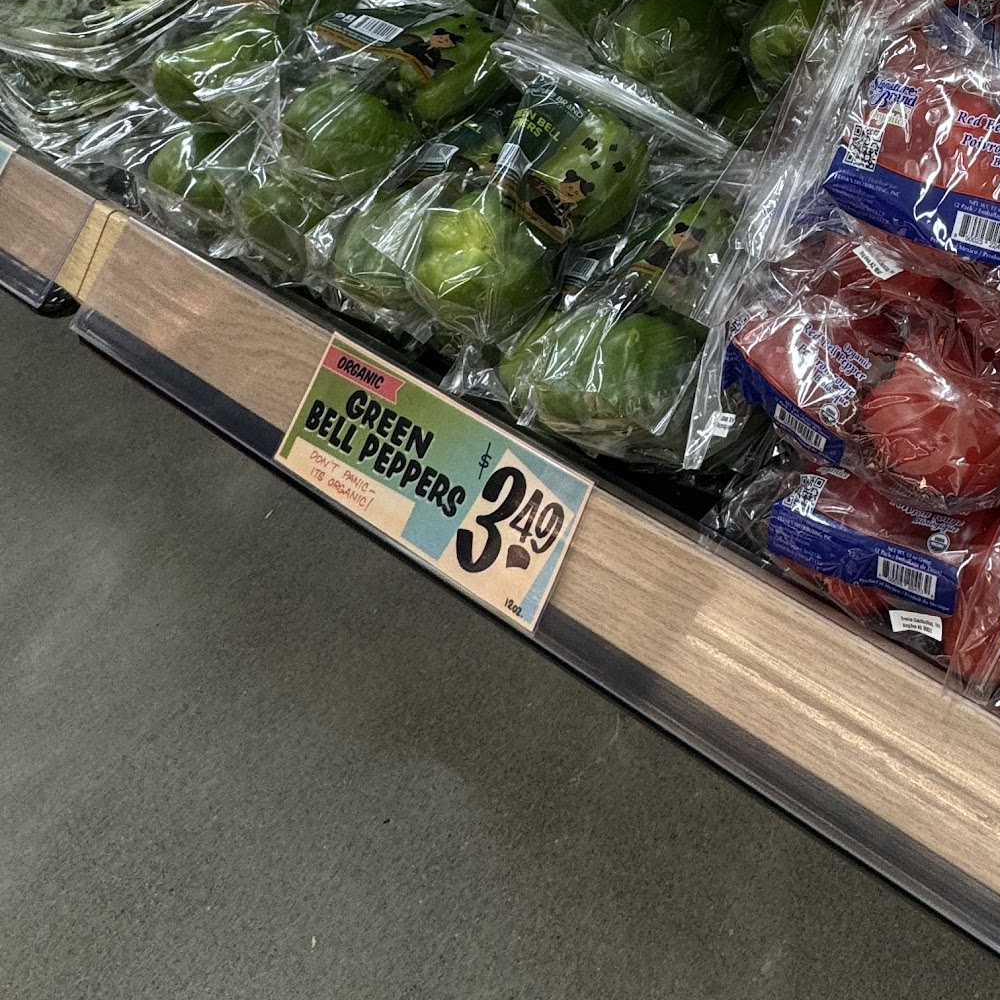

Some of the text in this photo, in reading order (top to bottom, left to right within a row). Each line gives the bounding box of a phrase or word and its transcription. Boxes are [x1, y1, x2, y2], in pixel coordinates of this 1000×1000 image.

[957, 110, 983, 127] Red
[802, 321, 867, 382] Red Pepper
[843, 342, 871, 370] Organic
[336, 356, 385, 390] ORGANIC
[345, 390, 434, 459] GREEN
[305, 400, 466, 518] BELL PEPPERS
[309, 450, 340, 470] DON'T
[327, 477, 375, 512] ORGANIC!
